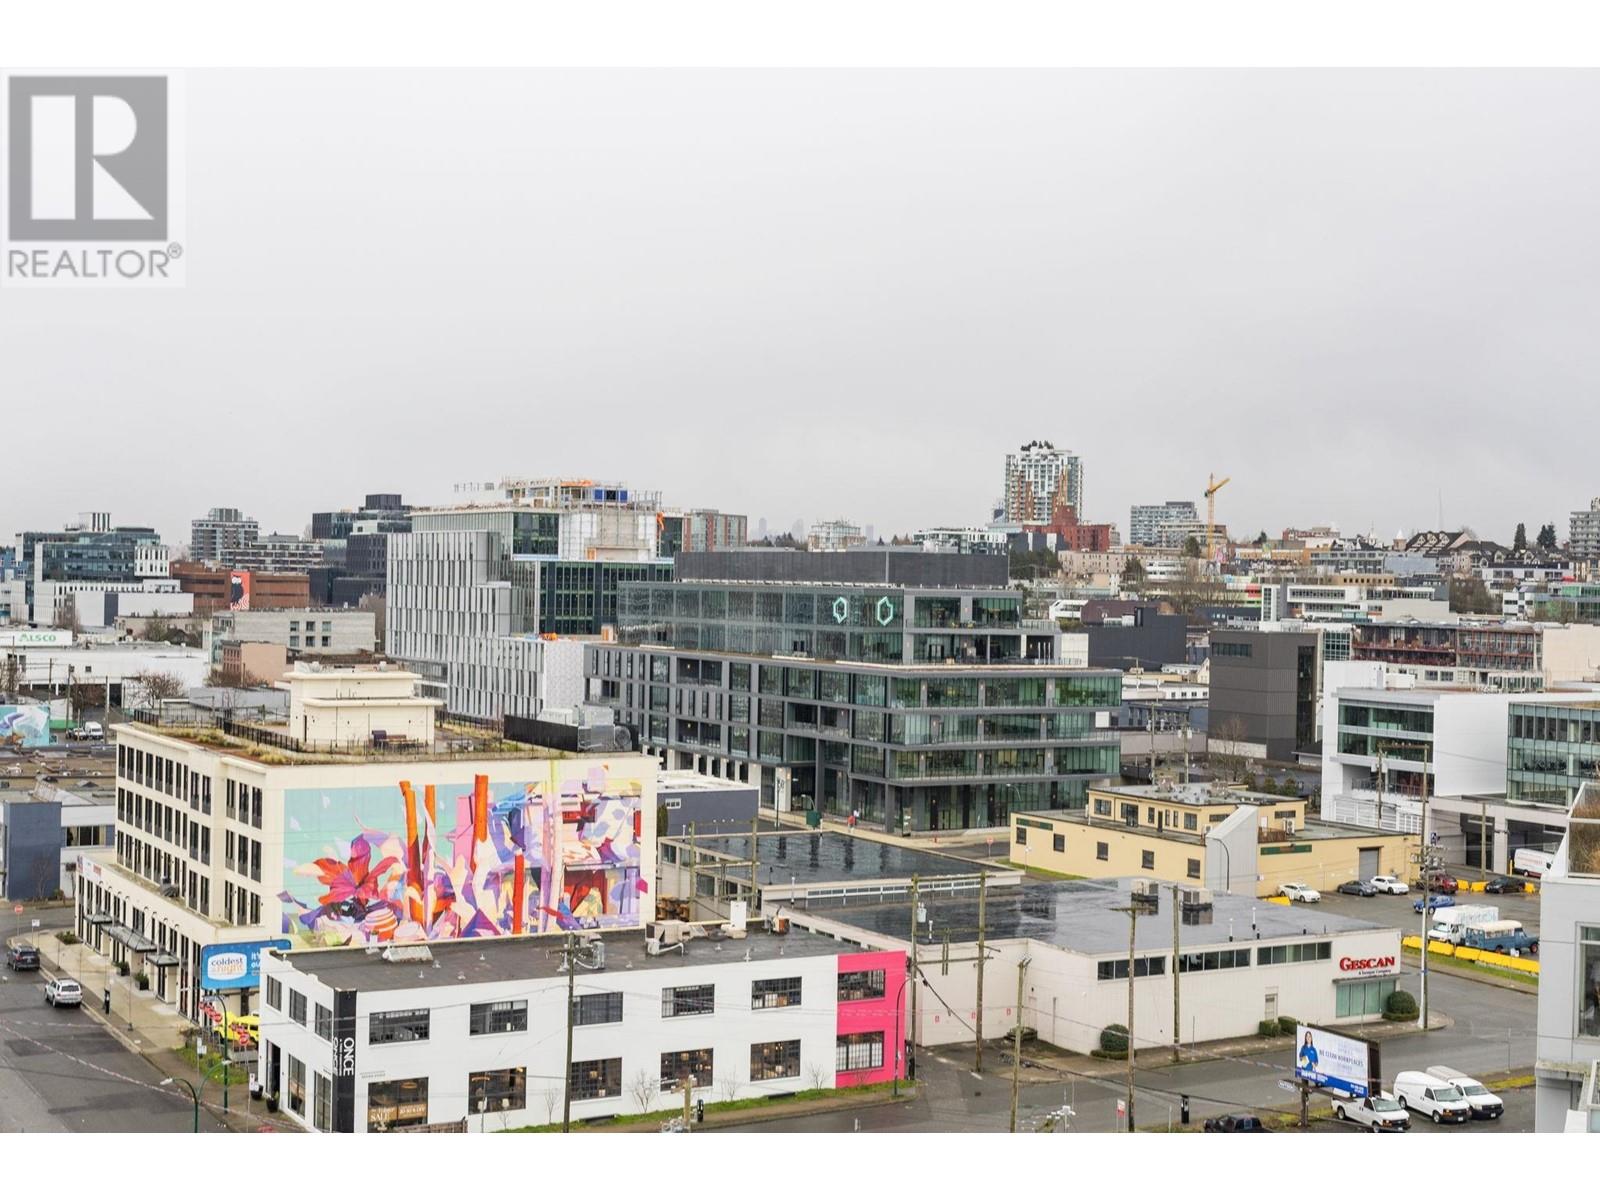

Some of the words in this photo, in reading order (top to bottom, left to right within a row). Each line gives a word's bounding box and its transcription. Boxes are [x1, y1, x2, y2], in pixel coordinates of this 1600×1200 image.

[211, 957, 243, 966] coldest
[1339, 956, 1395, 972] GESCAN
[343, 1037, 355, 1076] ONCE
